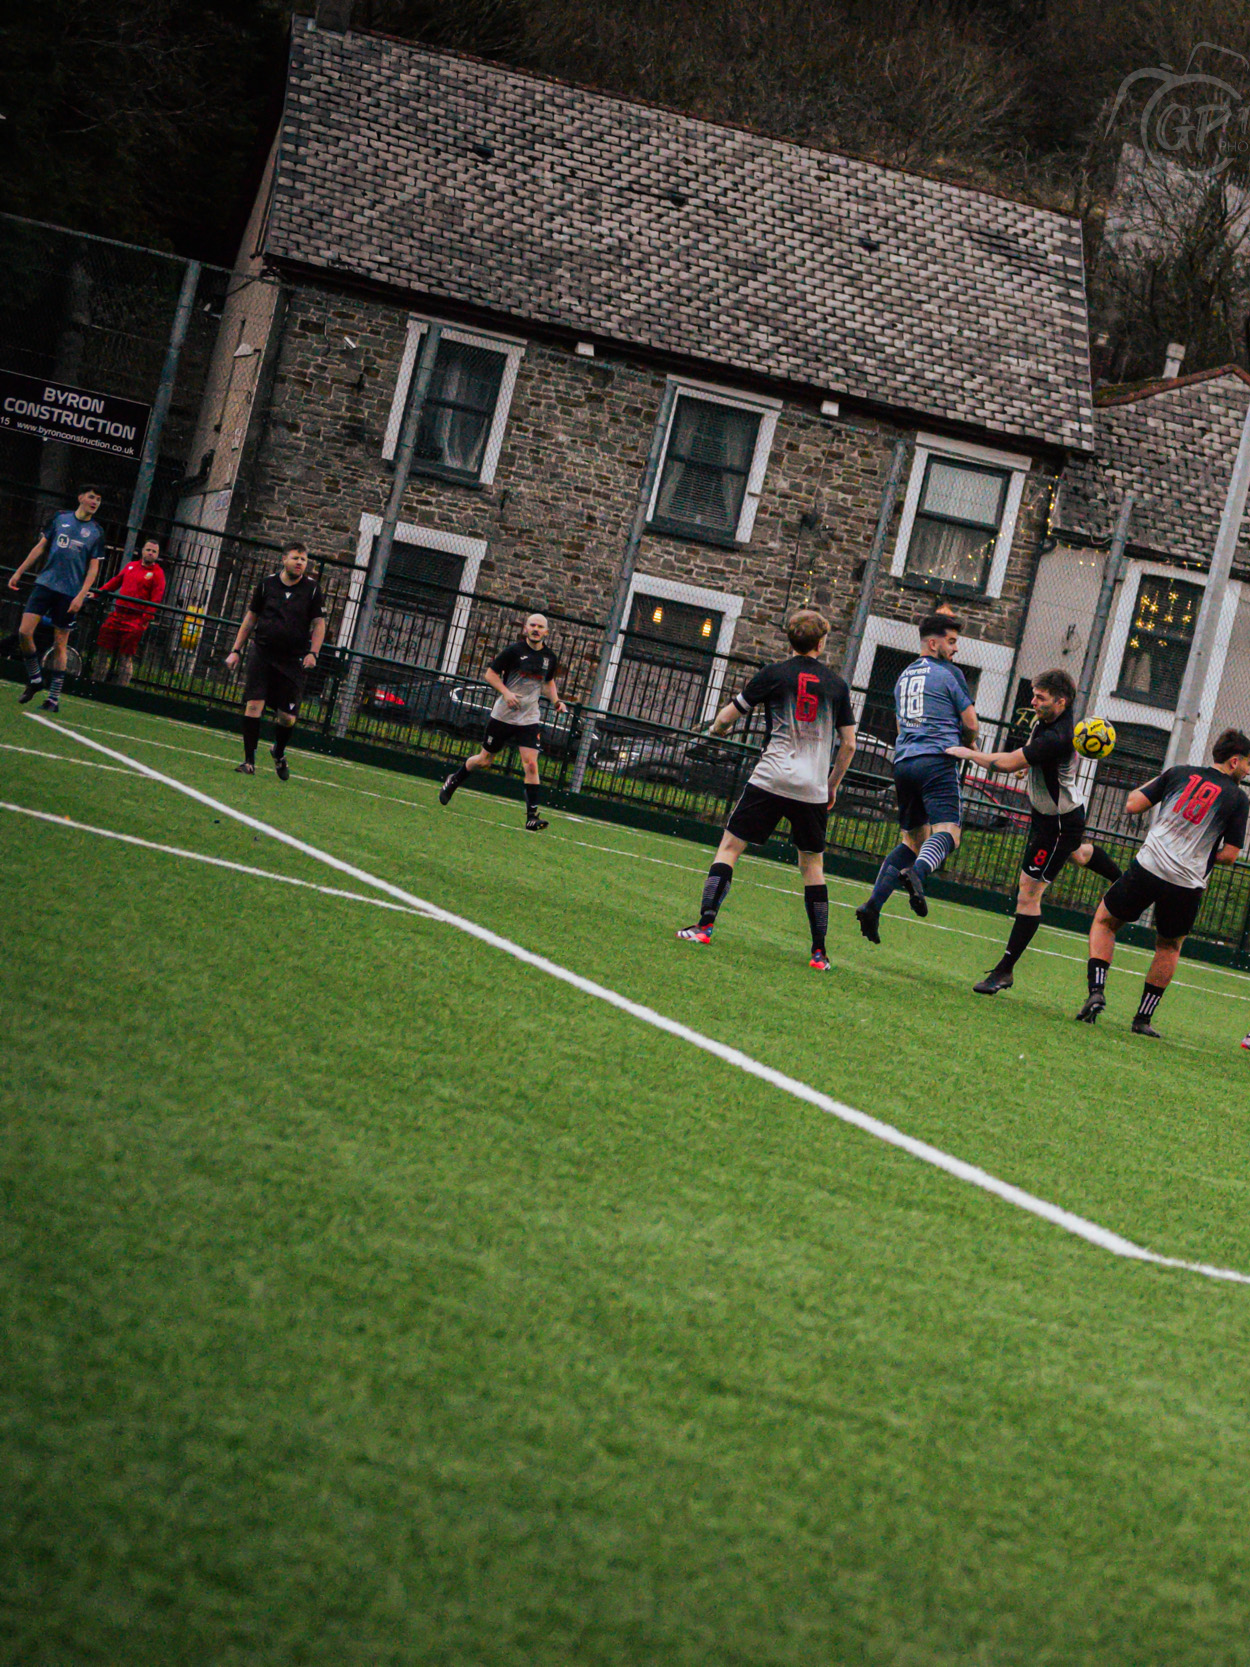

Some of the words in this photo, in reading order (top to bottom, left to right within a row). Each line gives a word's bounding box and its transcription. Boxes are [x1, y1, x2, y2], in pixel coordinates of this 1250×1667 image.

[4, 397, 136, 440] CONSTRUCTION
[43, 387, 105, 414] BYRON
[17, 422, 134, 455] www.byronconstruction.co.uk
[795, 672, 820, 722] 6
[899, 675, 926, 718] 18
[1172, 774, 1222, 825] 18
[1034, 849, 1048, 865] 8
